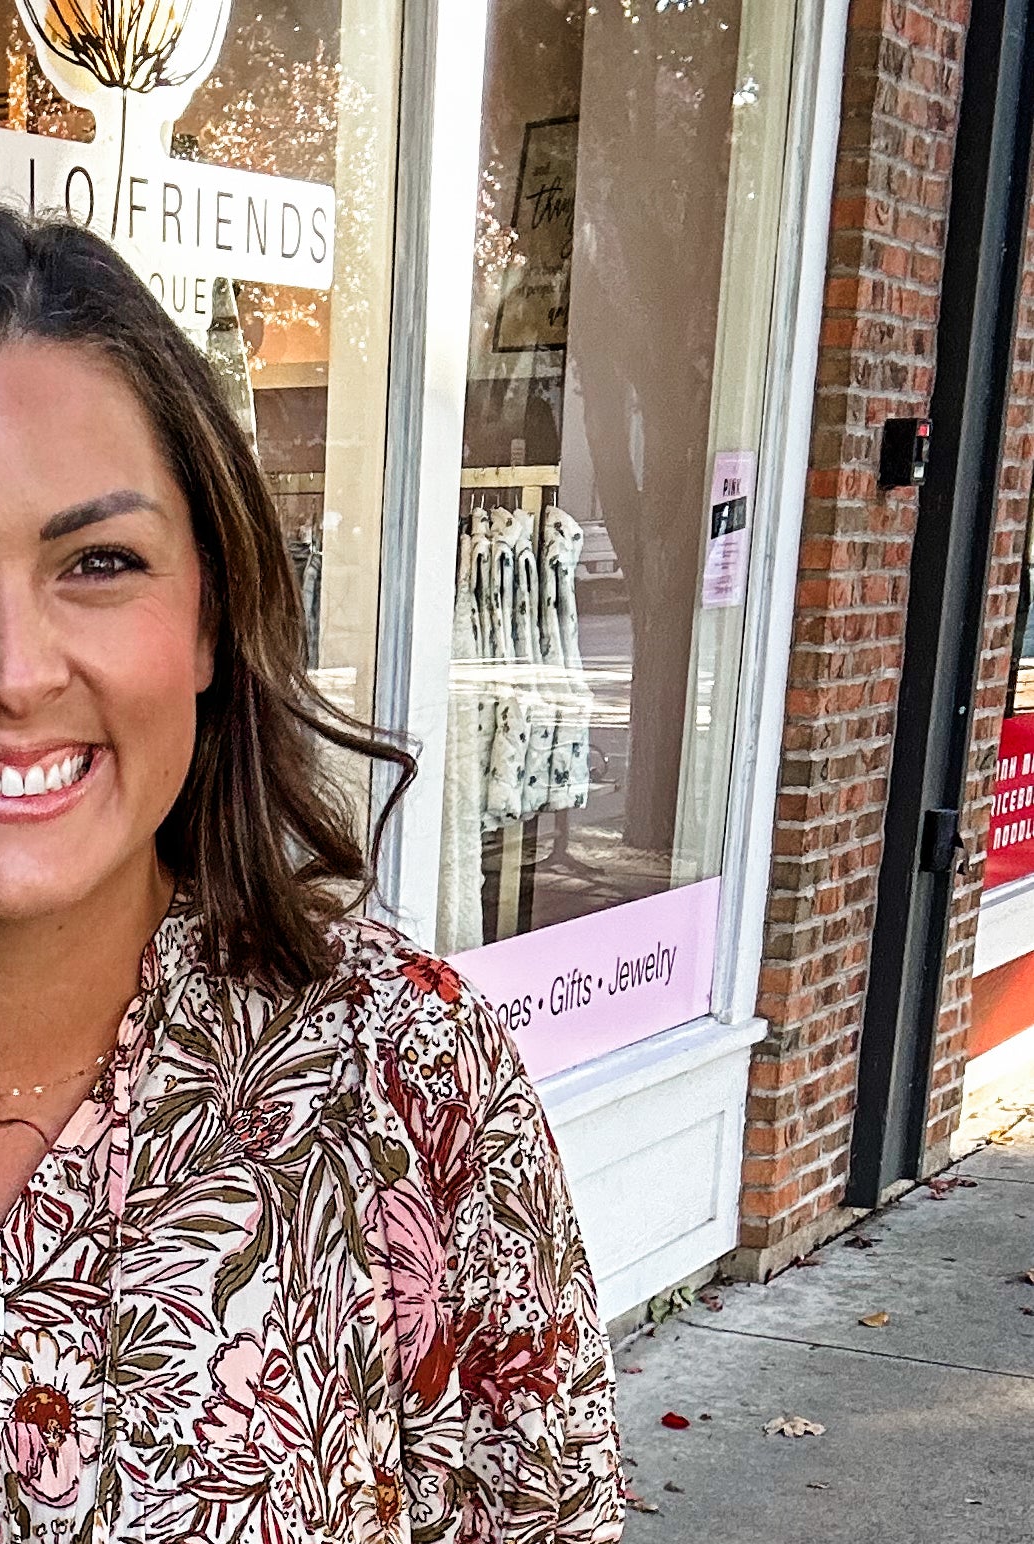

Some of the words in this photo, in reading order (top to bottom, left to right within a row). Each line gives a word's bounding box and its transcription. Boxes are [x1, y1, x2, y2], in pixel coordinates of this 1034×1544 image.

[129, 176, 327, 263] FRIENDS
[991, 785, 1034, 817] RICEBO
[993, 818, 1034, 850] NOODL
[550, 968, 592, 1016] Gifts
[609, 941, 677, 995] Jewelry
